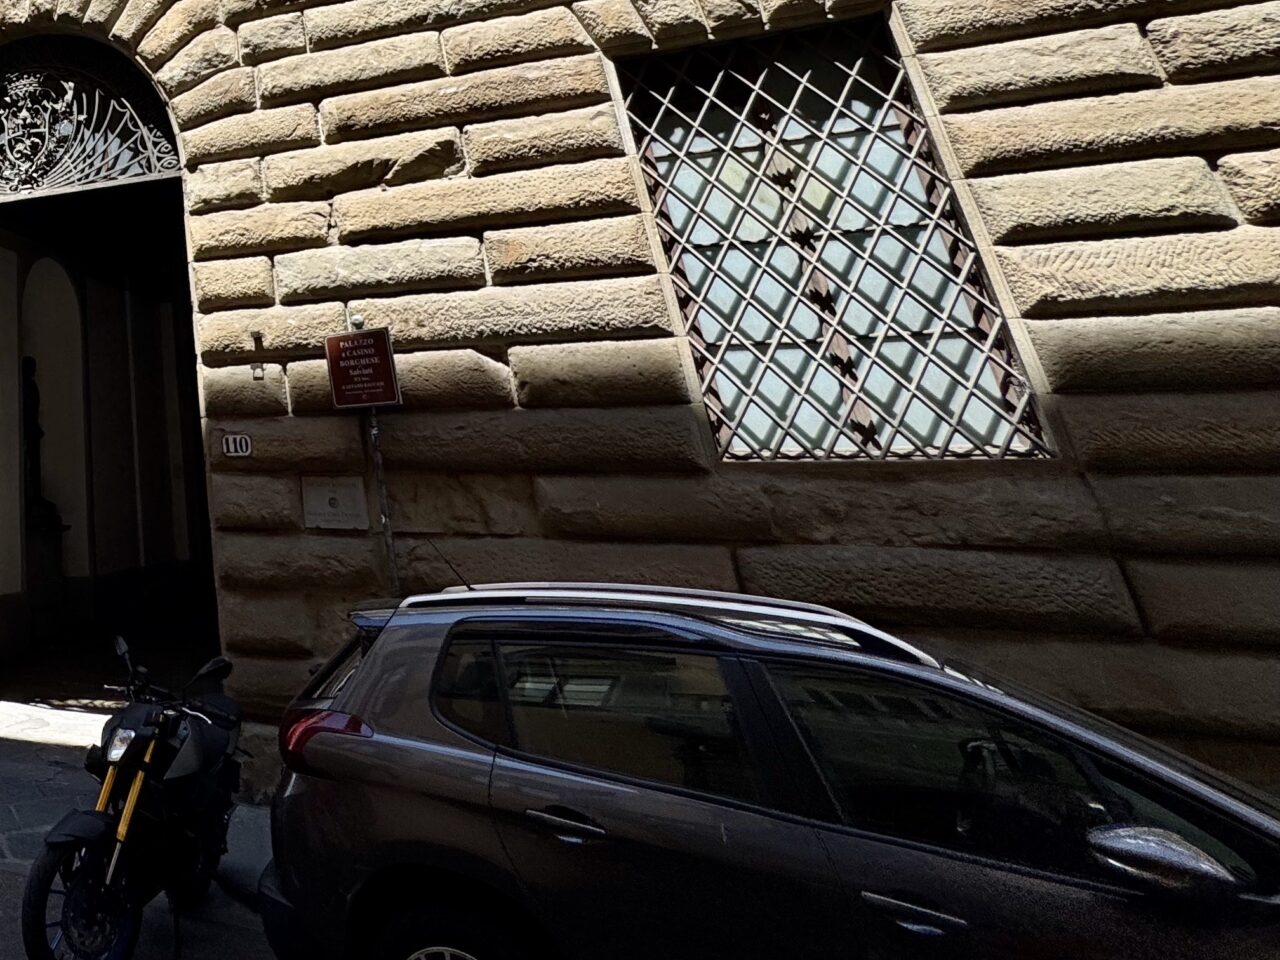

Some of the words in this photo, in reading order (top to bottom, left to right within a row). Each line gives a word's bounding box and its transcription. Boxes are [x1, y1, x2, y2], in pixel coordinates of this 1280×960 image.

[339, 338, 374, 349] PALAZZO
[346, 348, 375, 357] CASINO
[339, 357, 380, 367] BORGHESE
[225, 436, 249, 453] 110
